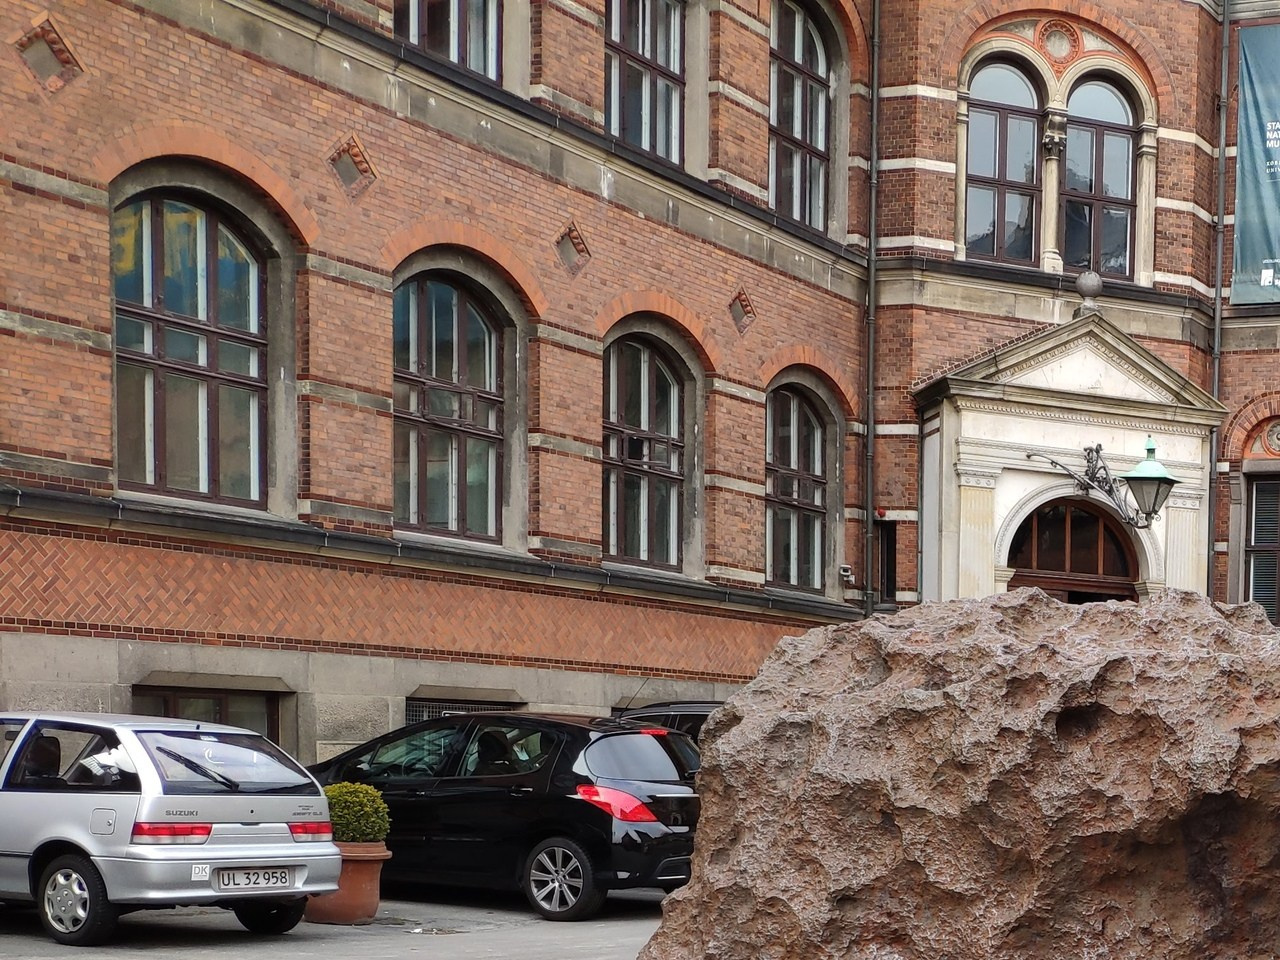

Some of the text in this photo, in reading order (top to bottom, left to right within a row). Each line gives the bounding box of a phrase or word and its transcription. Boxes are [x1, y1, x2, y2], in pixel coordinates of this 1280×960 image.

[194, 866, 208, 875] DK
[221, 871, 288, 887] UL 32 958
